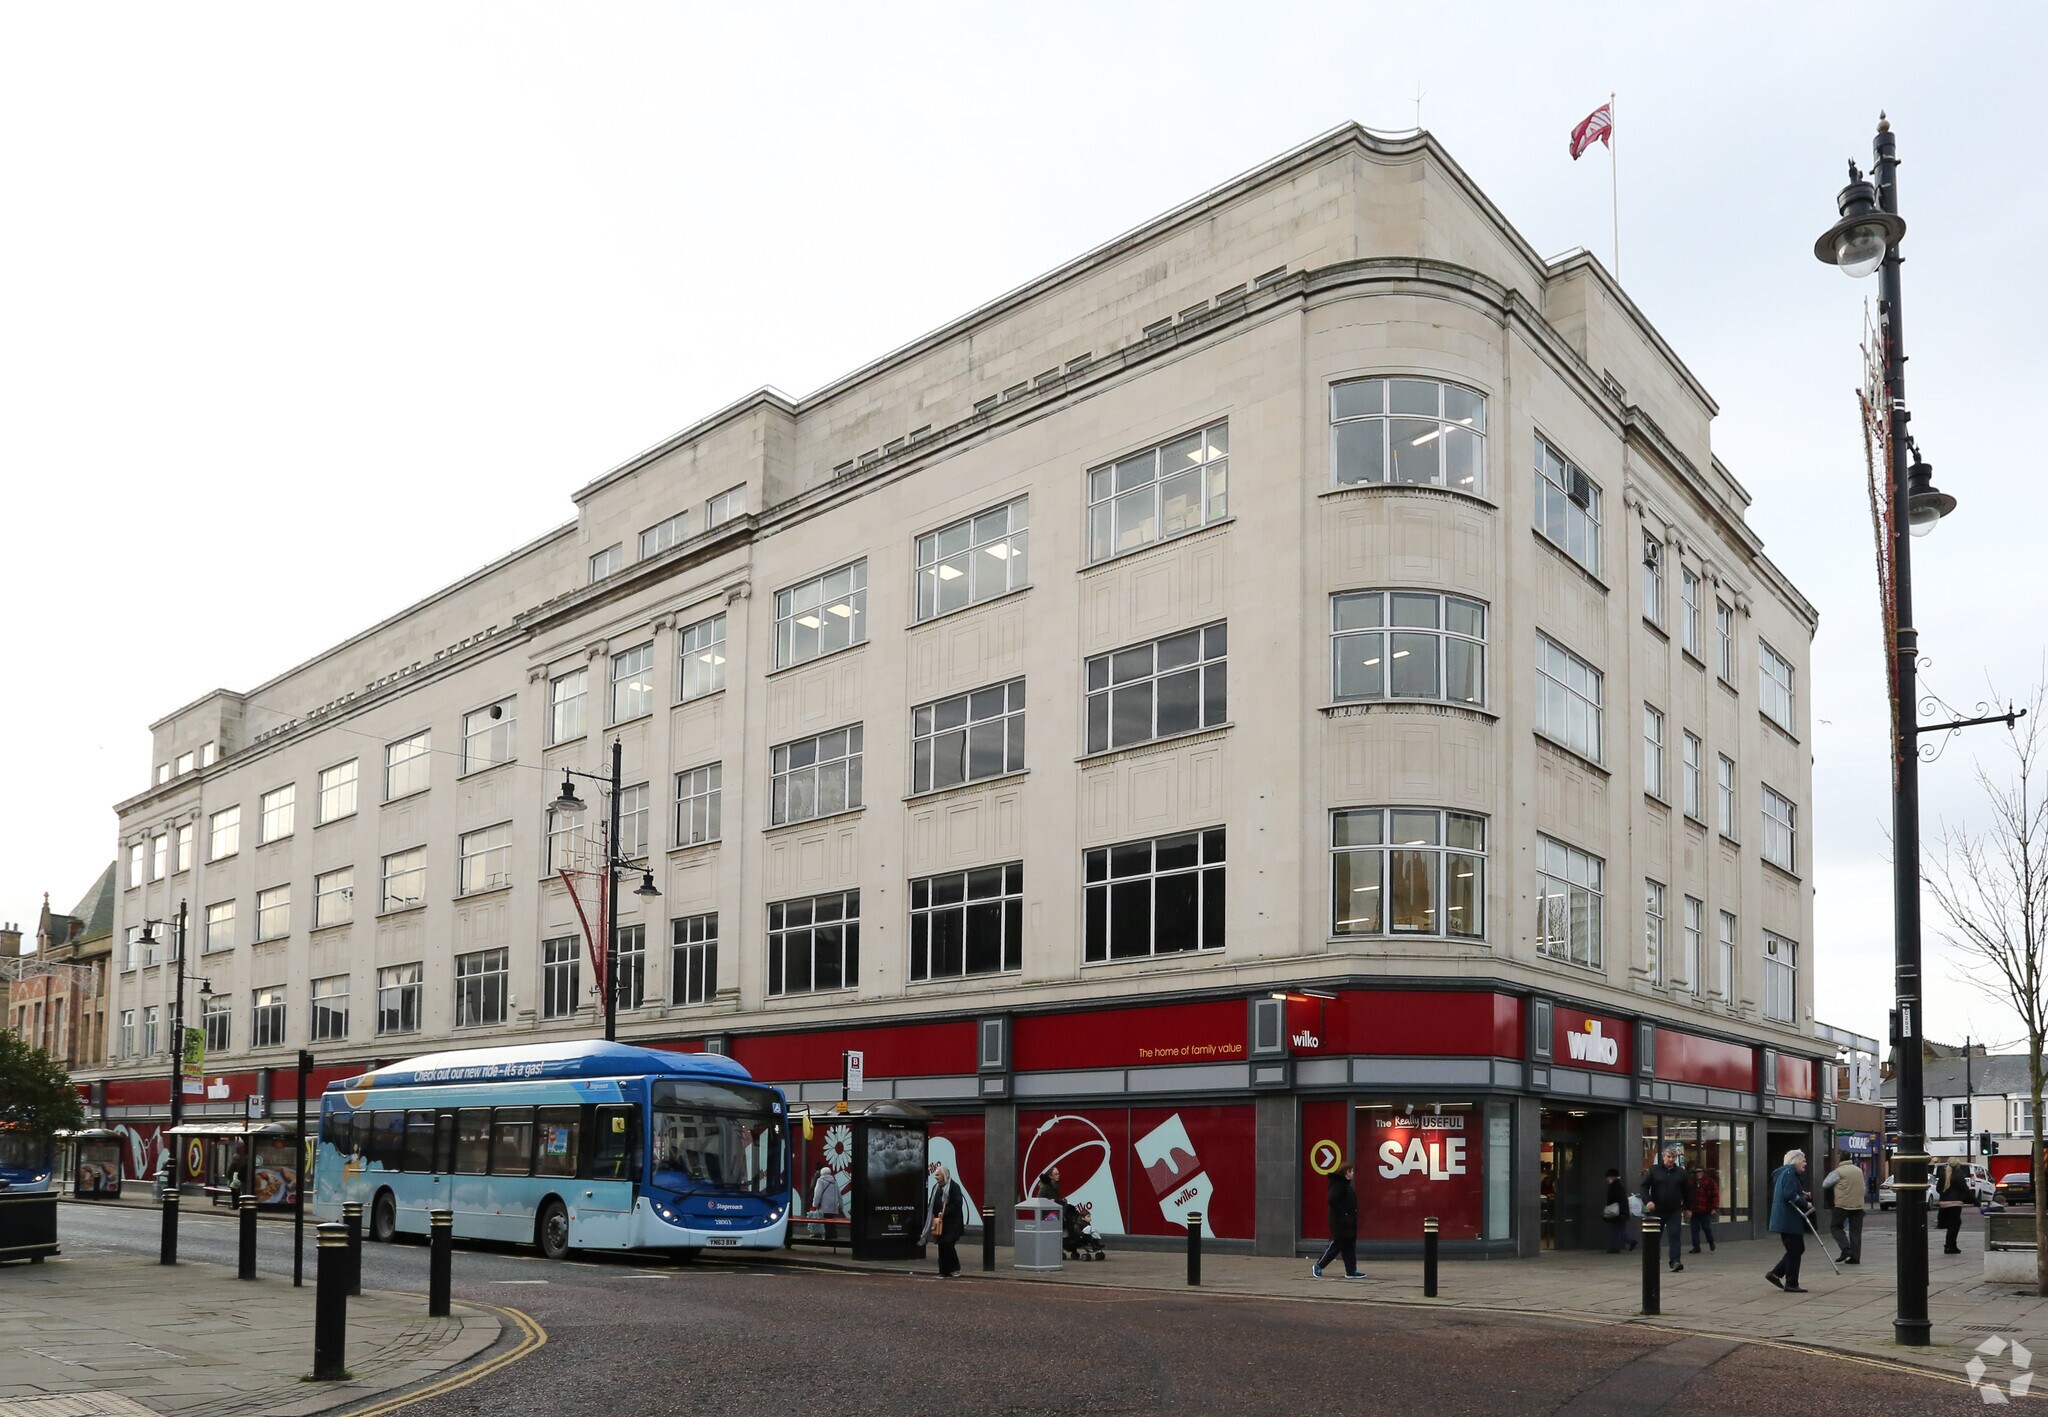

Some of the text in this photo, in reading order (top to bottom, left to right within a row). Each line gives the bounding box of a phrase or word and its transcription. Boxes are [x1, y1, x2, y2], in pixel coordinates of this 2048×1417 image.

[1292, 1030, 1319, 1048] wilko
[1567, 1019, 1618, 1065] wilko
[1139, 1043, 1242, 1057] The home of family value
[414, 1070, 437, 1082] Check
[437, 1068, 449, 1081] out
[451, 1068, 464, 1079] our
[464, 1067, 480, 1078] new
[482, 1065, 498, 1077] ride
[518, 1066, 524, 1075] a
[525, 1060, 544, 1077] gas!
[1376, 1116, 1463, 1129] The Really USEFUL
[1848, 1136, 1868, 1150] CORAL
[1378, 1138, 1466, 1180] SALE
[1174, 1187, 1198, 1207] wilko
